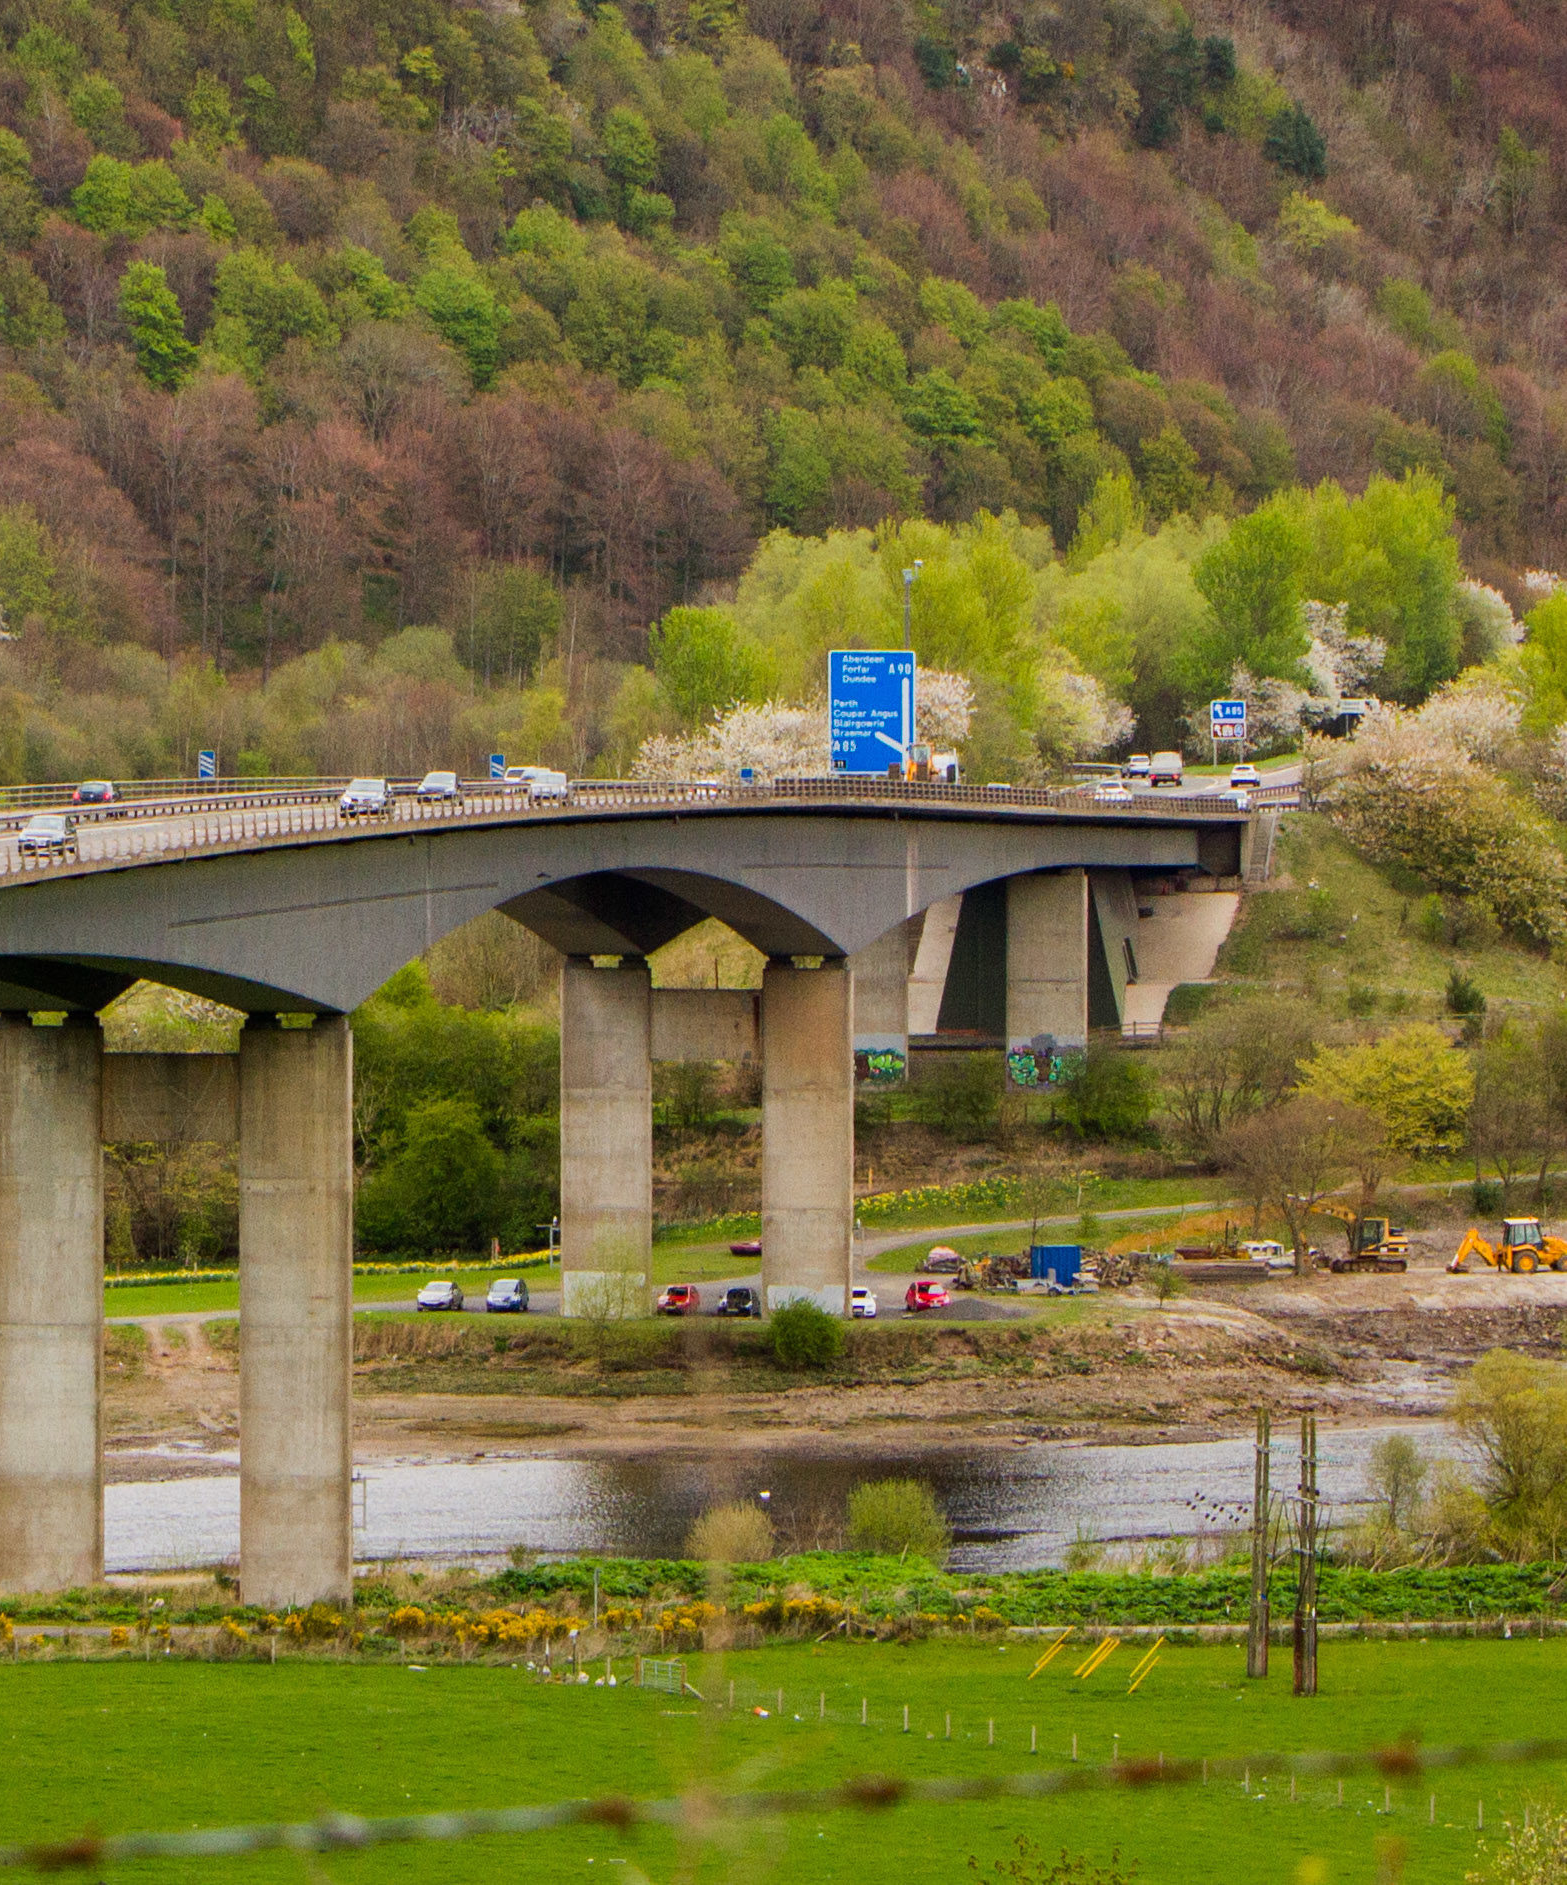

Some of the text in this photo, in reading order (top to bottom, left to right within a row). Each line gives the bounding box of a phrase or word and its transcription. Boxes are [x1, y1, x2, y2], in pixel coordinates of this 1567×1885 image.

[842, 654, 885, 663] Aberdeen
[842, 664, 870, 673] Forfar
[842, 675, 877, 683] Dundee
[834, 699, 858, 707] Perth
[834, 709, 898, 719] Coupar Angus
[834, 719, 885, 729] Blairgowrie
[833, 728, 872, 737] Braemar
